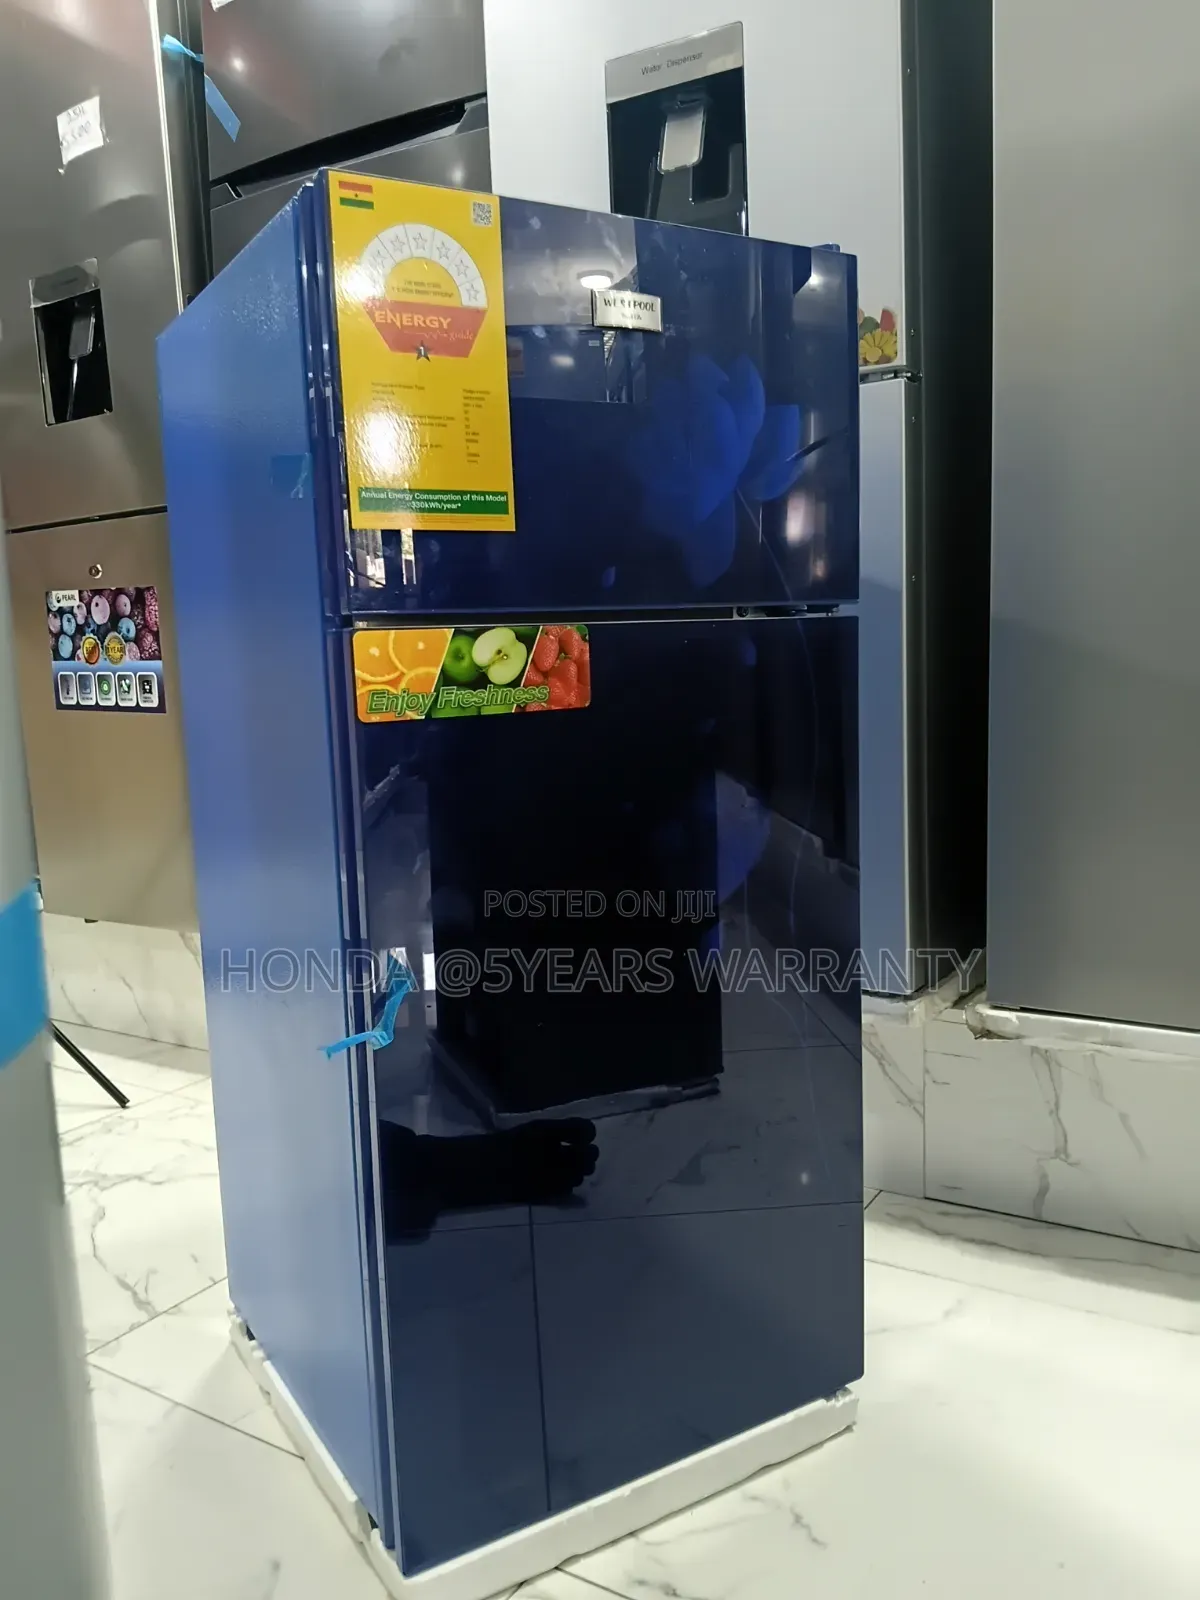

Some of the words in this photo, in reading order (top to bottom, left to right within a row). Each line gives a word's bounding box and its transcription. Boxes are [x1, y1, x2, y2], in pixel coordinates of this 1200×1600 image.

[641, 63, 663, 75] Water
[374, 308, 452, 329] ENERGY
[419, 346, 425, 356] 1
[361, 491, 387, 499] Annual
[388, 492, 413, 501] Energy
[414, 493, 462, 502] Consumption
[463, 493, 471, 501] of
[472, 493, 485, 502] this
[485, 494, 507, 502] Model
[62, 592, 77, 602] PEARL
[367, 688, 434, 716] Enjoy
[437, 684, 550, 709] Freshness
